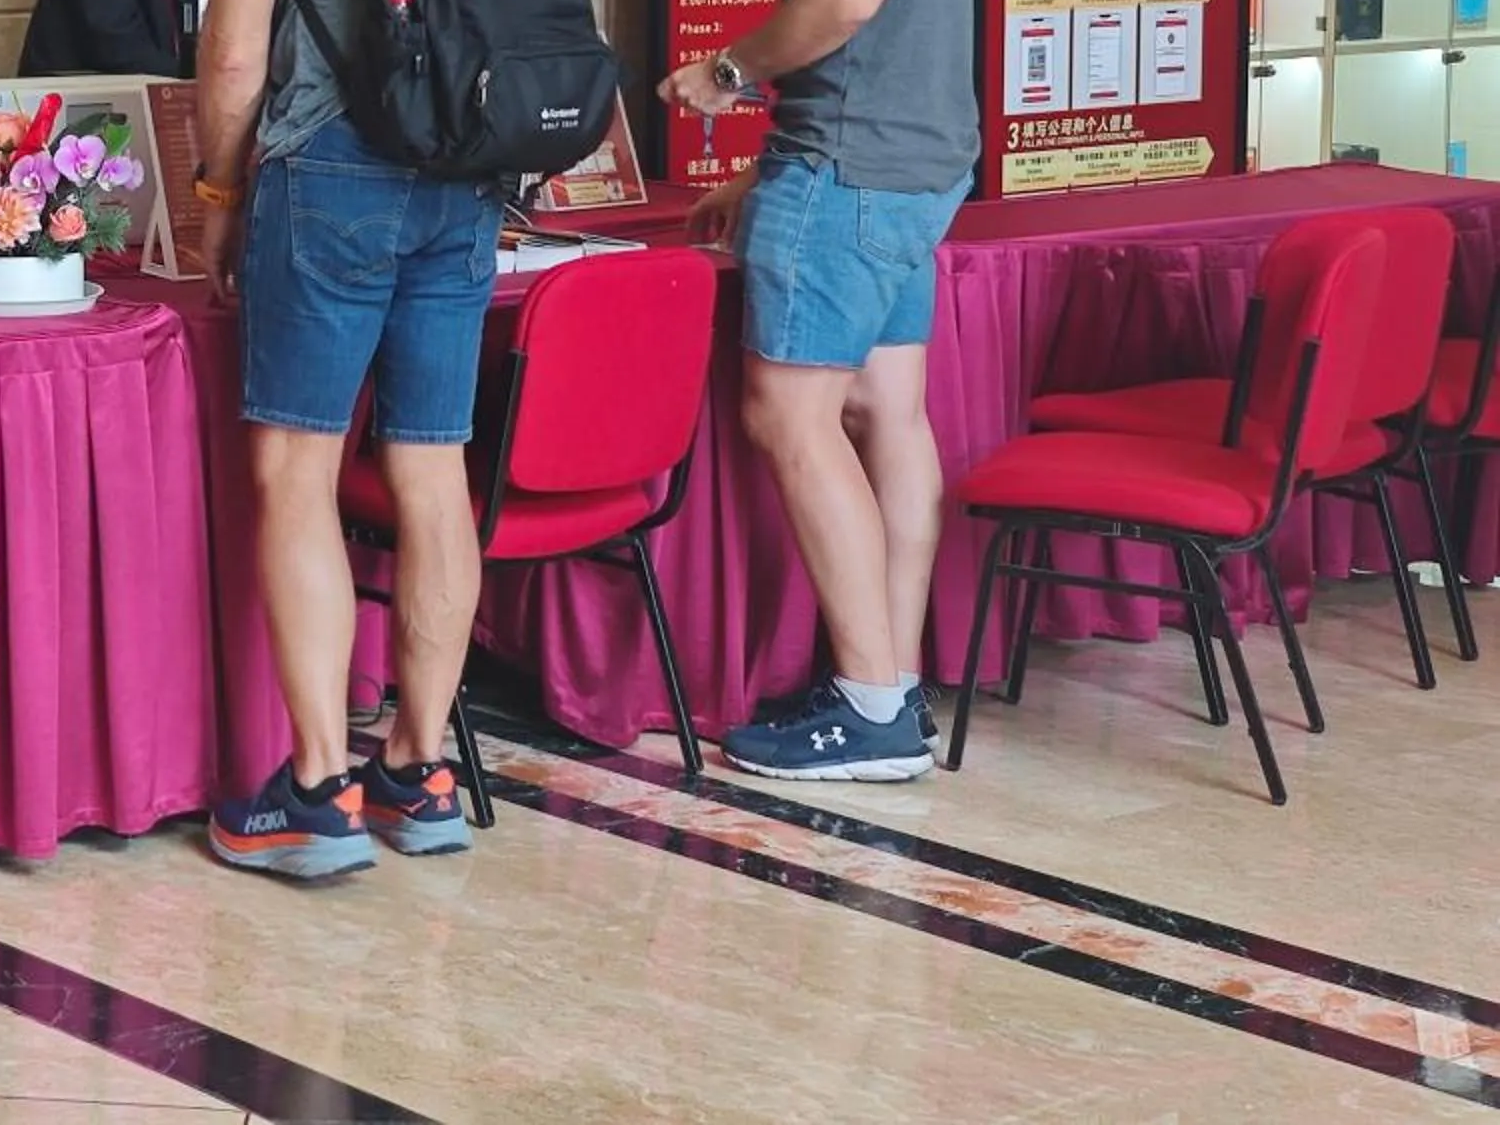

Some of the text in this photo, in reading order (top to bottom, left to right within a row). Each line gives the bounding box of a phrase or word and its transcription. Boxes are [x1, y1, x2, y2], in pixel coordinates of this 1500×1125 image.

[679, 23, 711, 35] Phase
[1007, 113, 1134, 150] 3 填写公司和个人信息
[243, 809, 288, 835] HOKA
